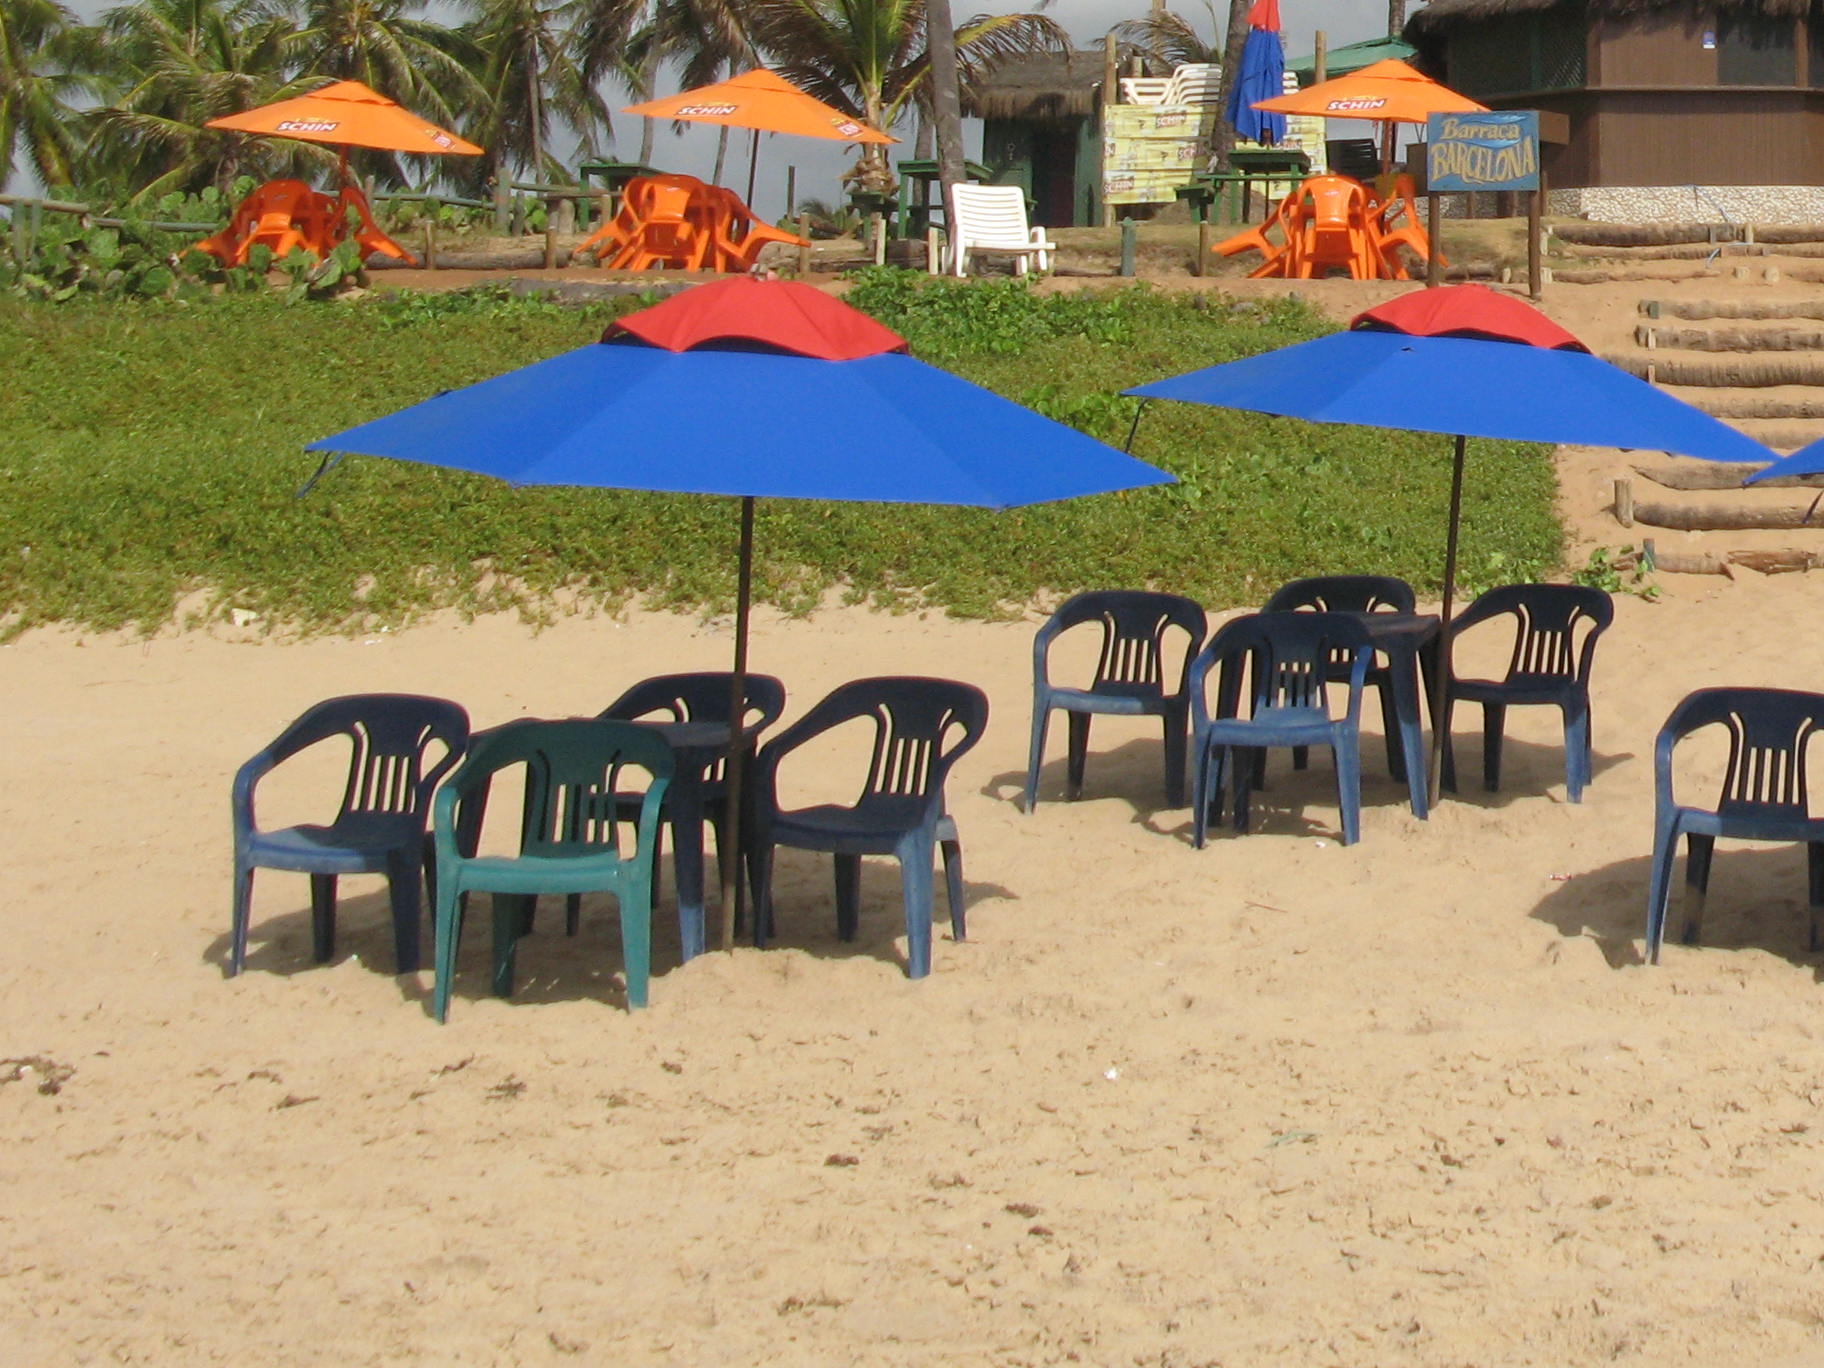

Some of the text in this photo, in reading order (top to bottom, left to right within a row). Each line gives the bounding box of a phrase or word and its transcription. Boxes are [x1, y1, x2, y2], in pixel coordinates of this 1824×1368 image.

[677, 105, 737, 115] SCHIN
[1327, 98, 1386, 110] SCHIN
[277, 121, 338, 132] SCHIN
[1440, 117, 1520, 141] Barraca
[1431, 135, 1537, 185] BARCELONA
